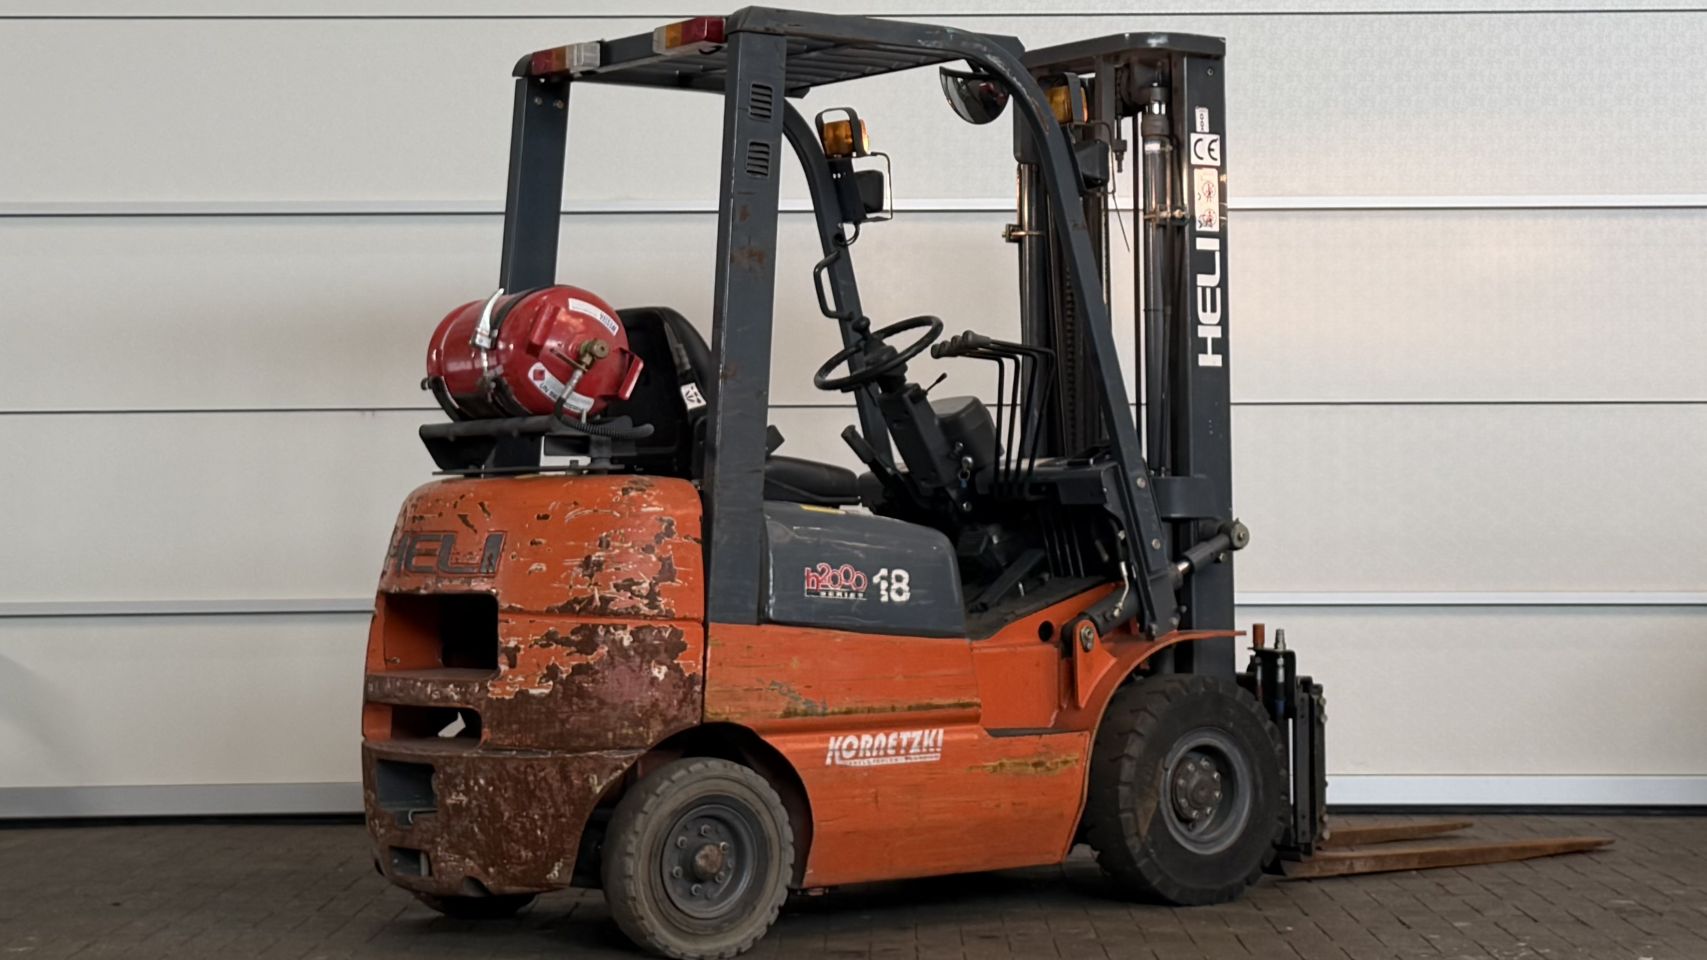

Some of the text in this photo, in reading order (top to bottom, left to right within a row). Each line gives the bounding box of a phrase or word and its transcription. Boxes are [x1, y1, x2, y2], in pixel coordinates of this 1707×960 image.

[1194, 138, 1219, 161] CE
[1196, 237, 1222, 367] HELI
[872, 567, 911, 602] 18
